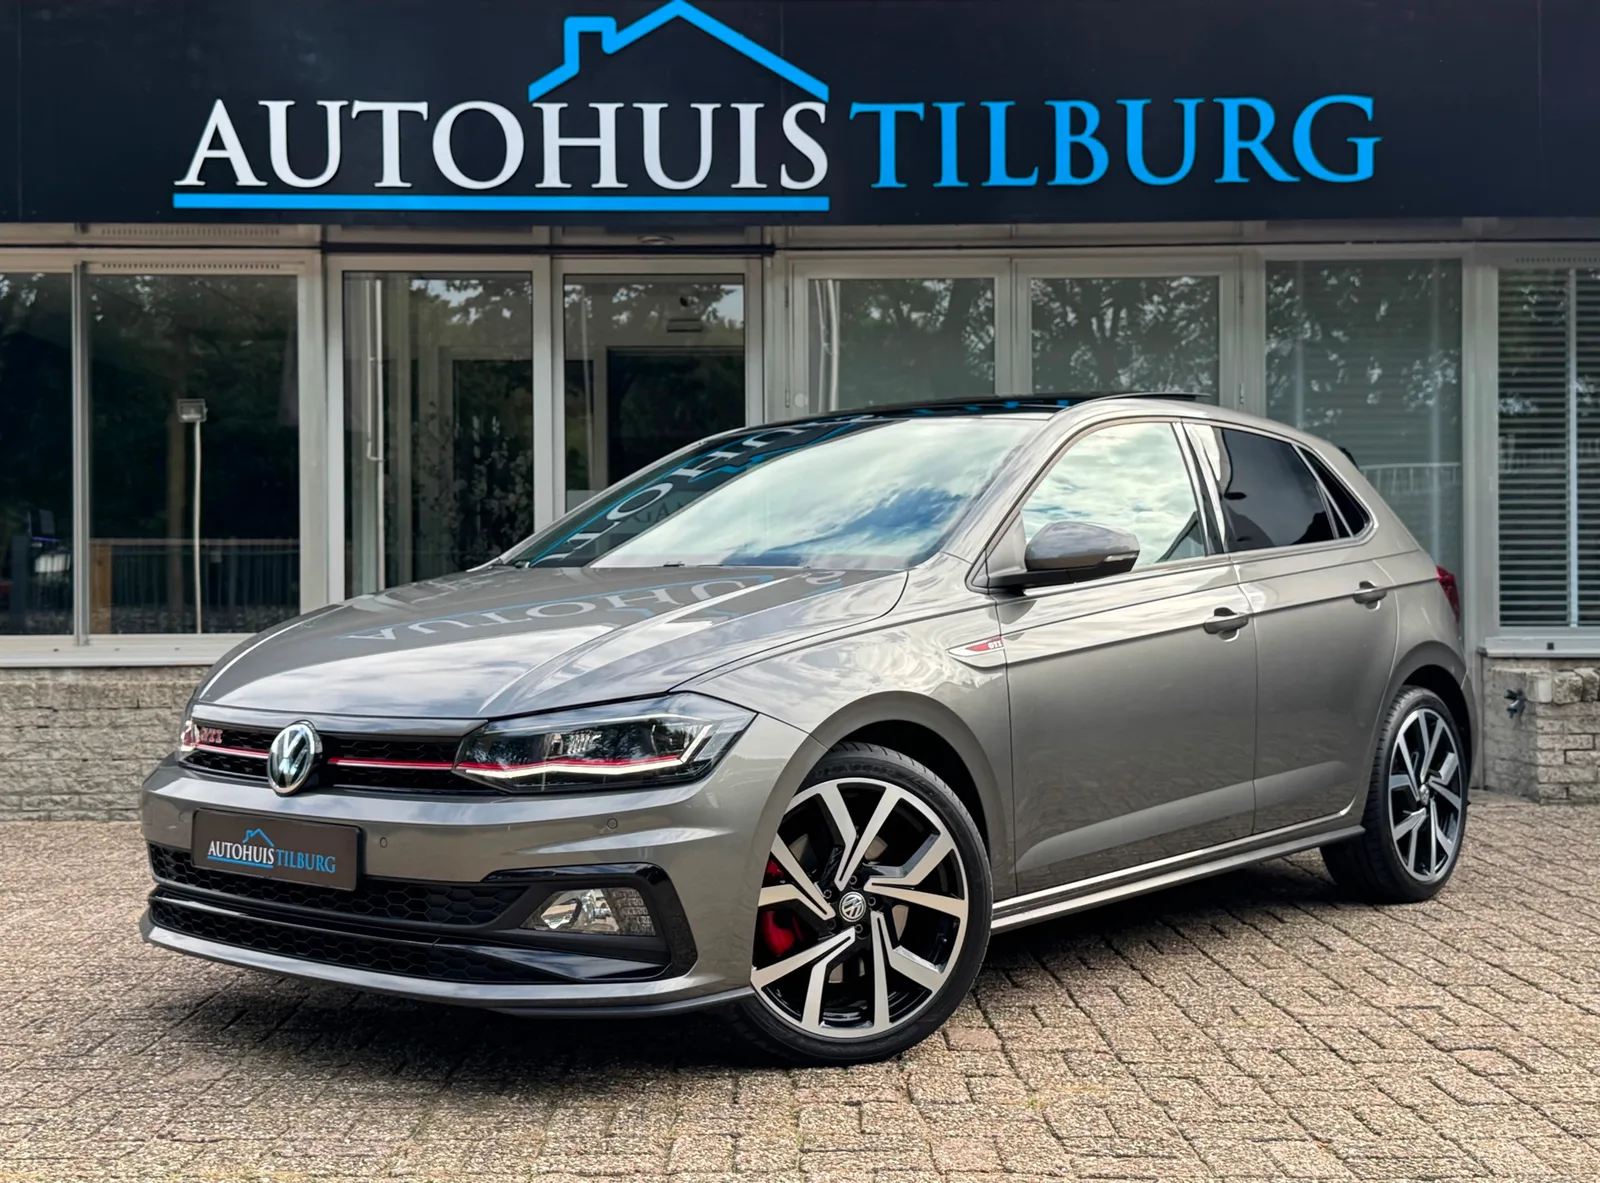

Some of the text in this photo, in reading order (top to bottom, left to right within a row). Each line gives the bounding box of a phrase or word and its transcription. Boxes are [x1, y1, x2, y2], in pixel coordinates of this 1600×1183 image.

[173, 94, 1384, 191] AUTOHUIS TILBURG
[987, 640, 1003, 650] GTI
[207, 840, 337, 874] AUTOHUIS TILBURG
